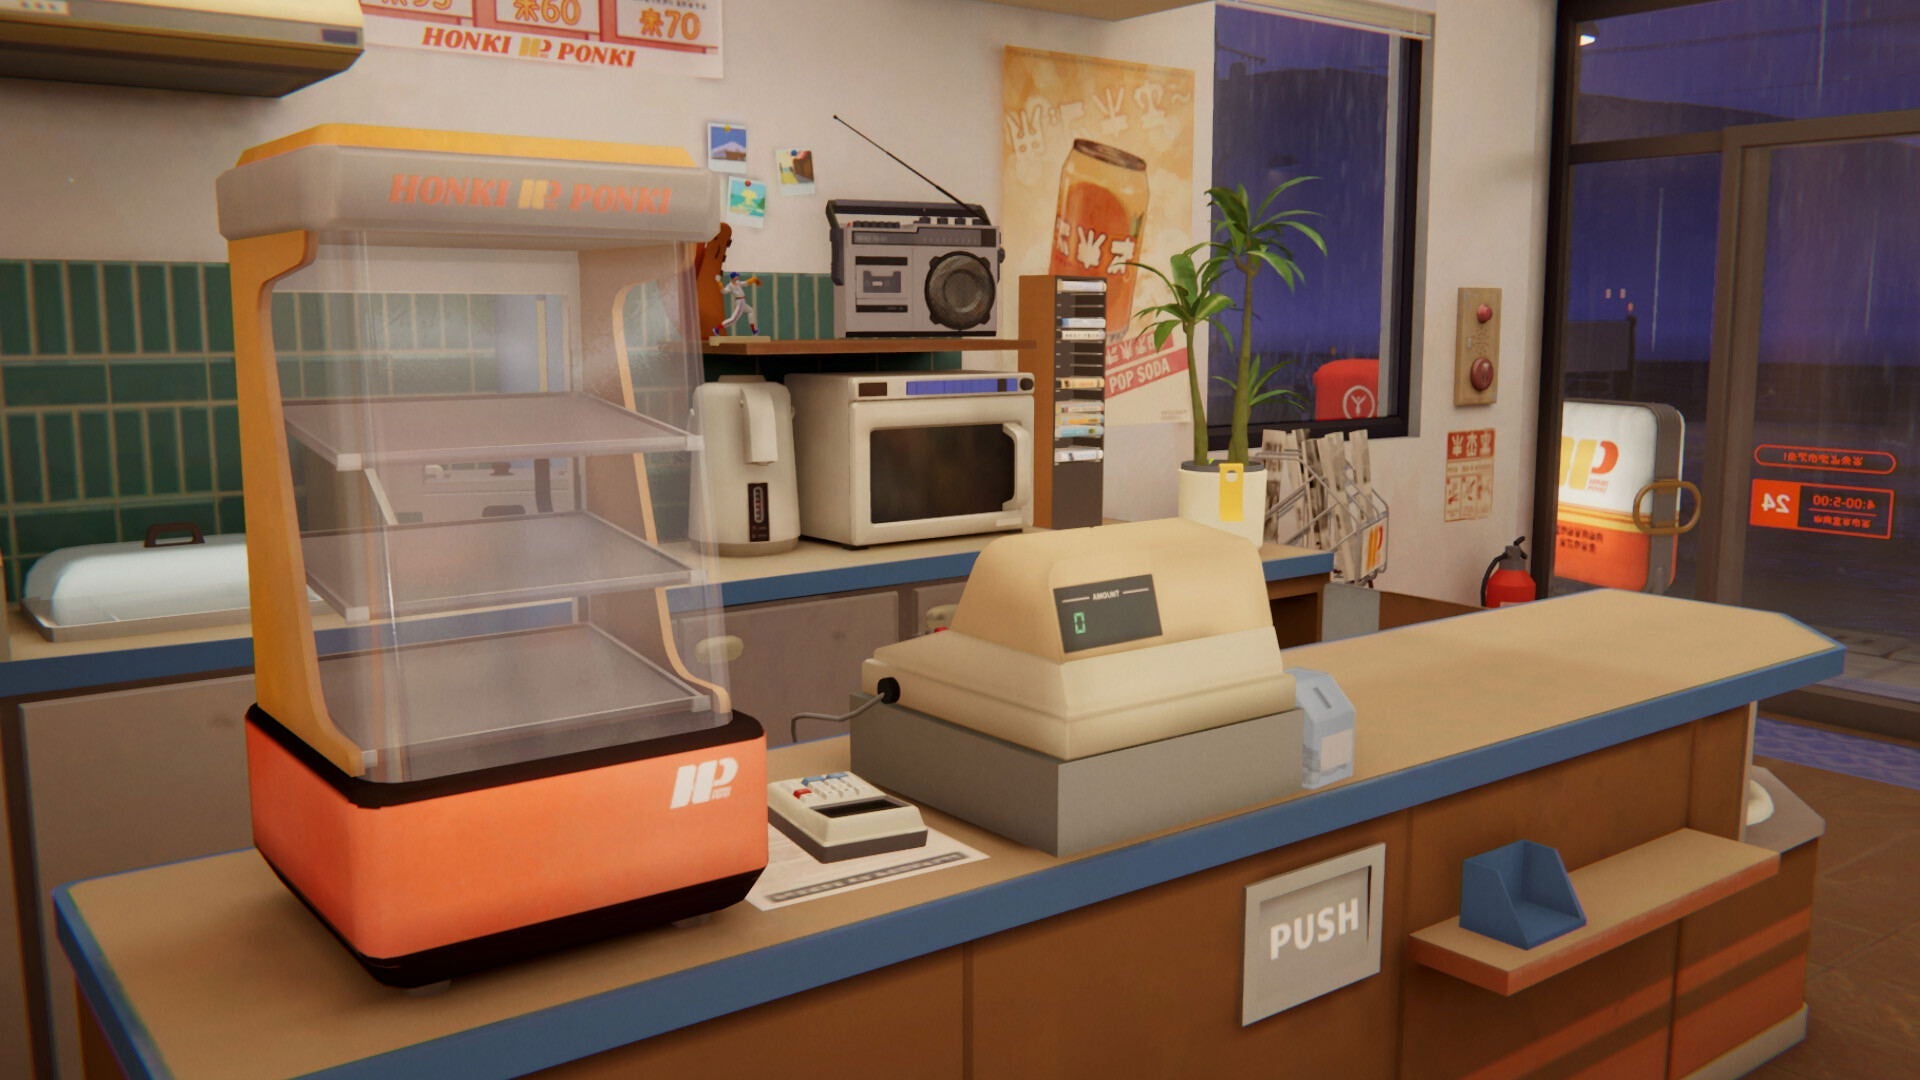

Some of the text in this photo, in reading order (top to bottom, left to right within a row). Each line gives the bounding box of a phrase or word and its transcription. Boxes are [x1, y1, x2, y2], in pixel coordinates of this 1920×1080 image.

[422, 26, 512, 55] HONKI
[557, 42, 637, 68] PONKI
[388, 173, 512, 208] HONKI
[569, 182, 673, 215] PONKI
[1109, 358, 1171, 394] POP SODA
[1092, 589, 1120, 601] AMOUNT
[1073, 611, 1086, 635] 0
[1270, 897, 1360, 961] PUSH
